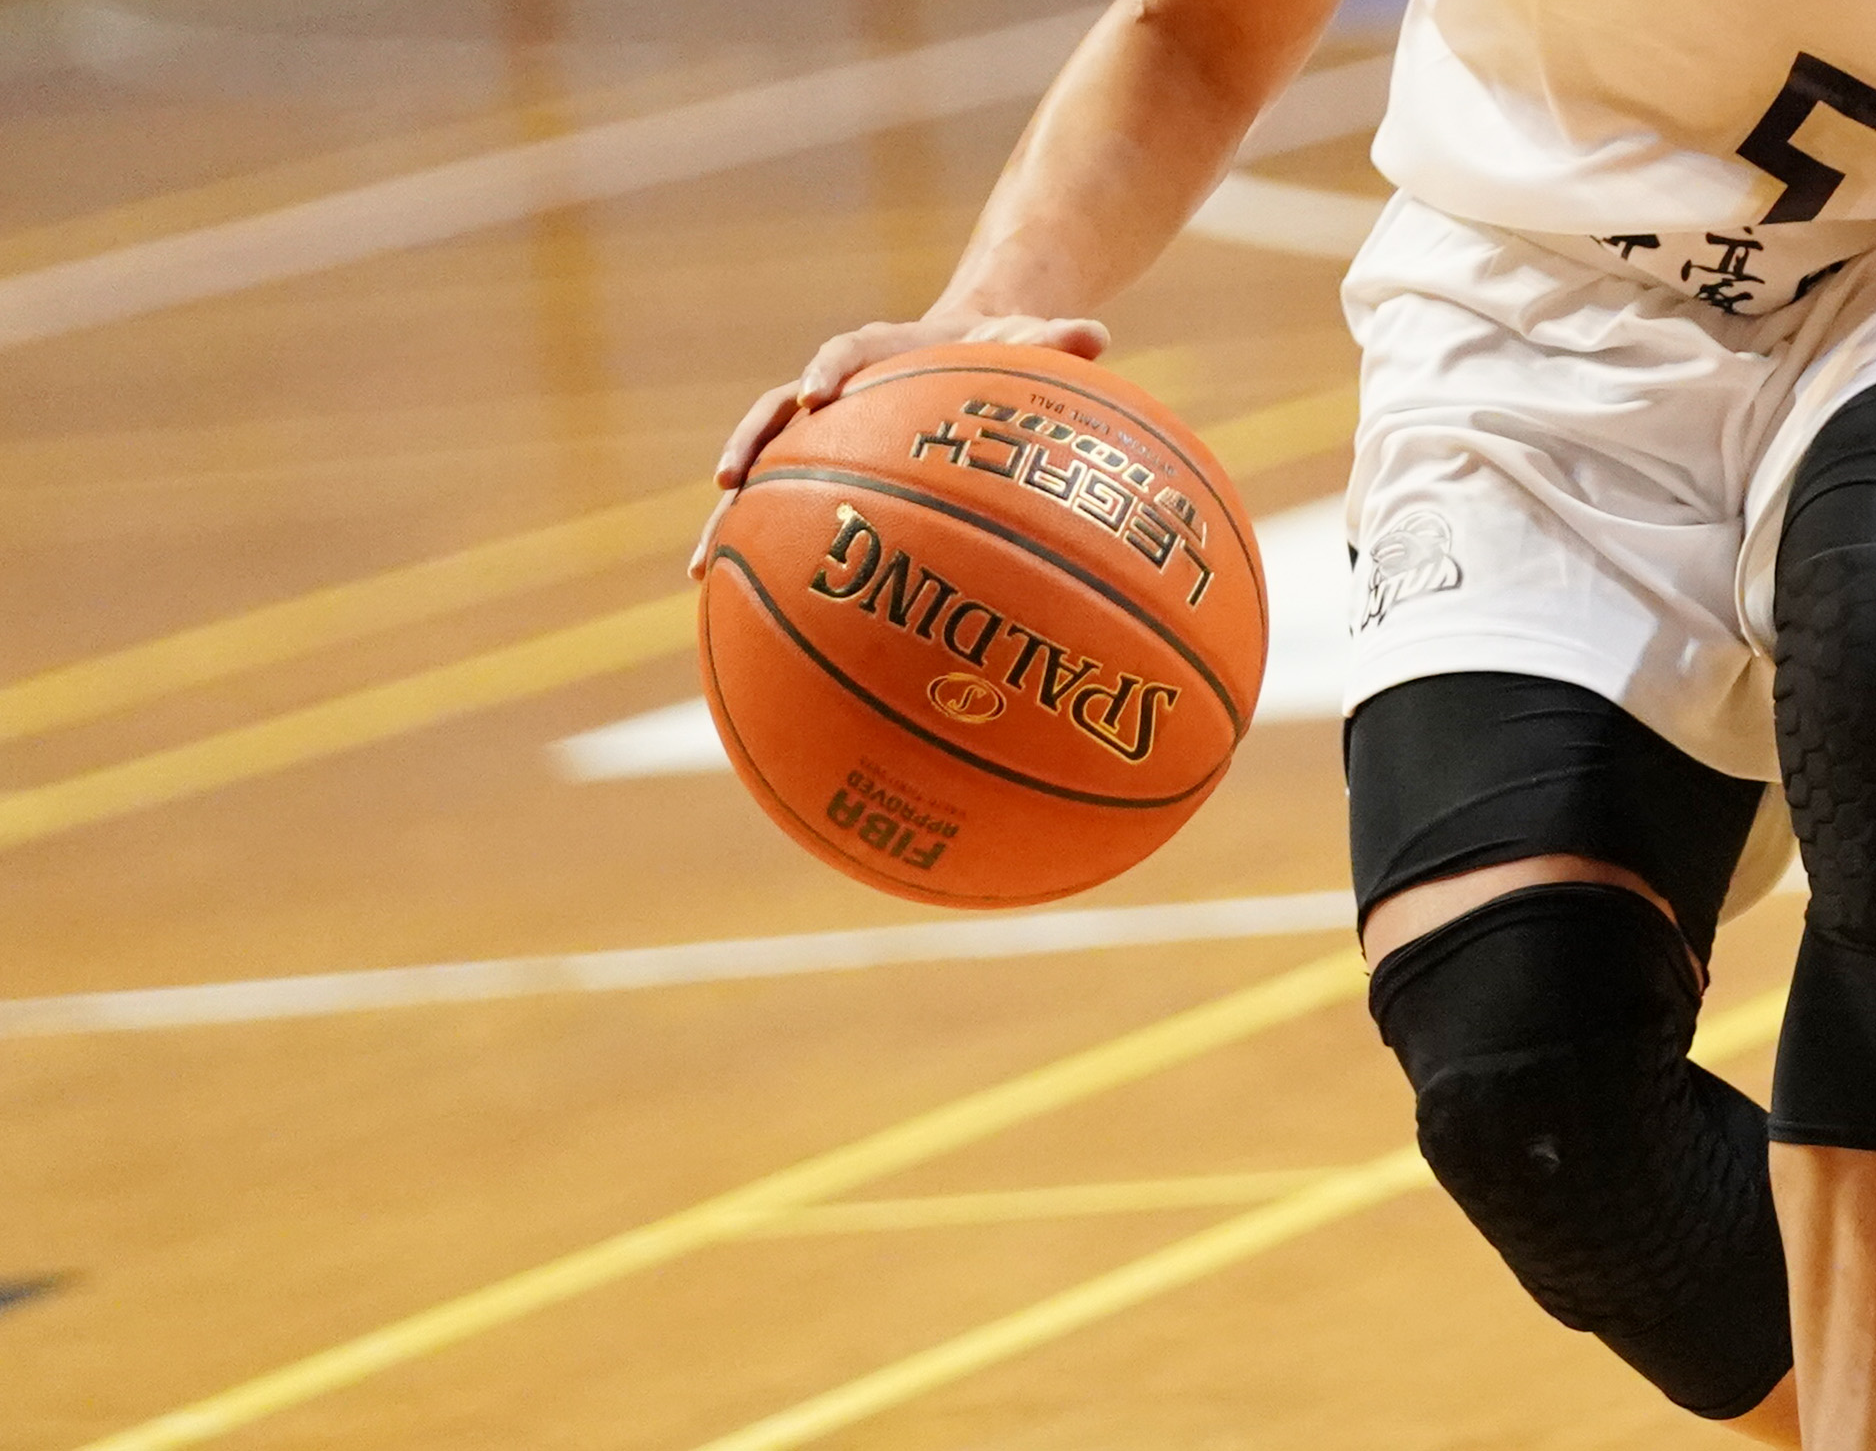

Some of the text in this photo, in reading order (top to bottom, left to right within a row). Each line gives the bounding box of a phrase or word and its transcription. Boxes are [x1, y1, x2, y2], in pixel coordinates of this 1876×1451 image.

[1030, 393, 1065, 415] BALL
[909, 421, 1215, 610] LEGACY
[808, 503, 1183, 765] SPALDING
[826, 787, 947, 871] FIBA
[847, 770, 960, 839] APPROVED
